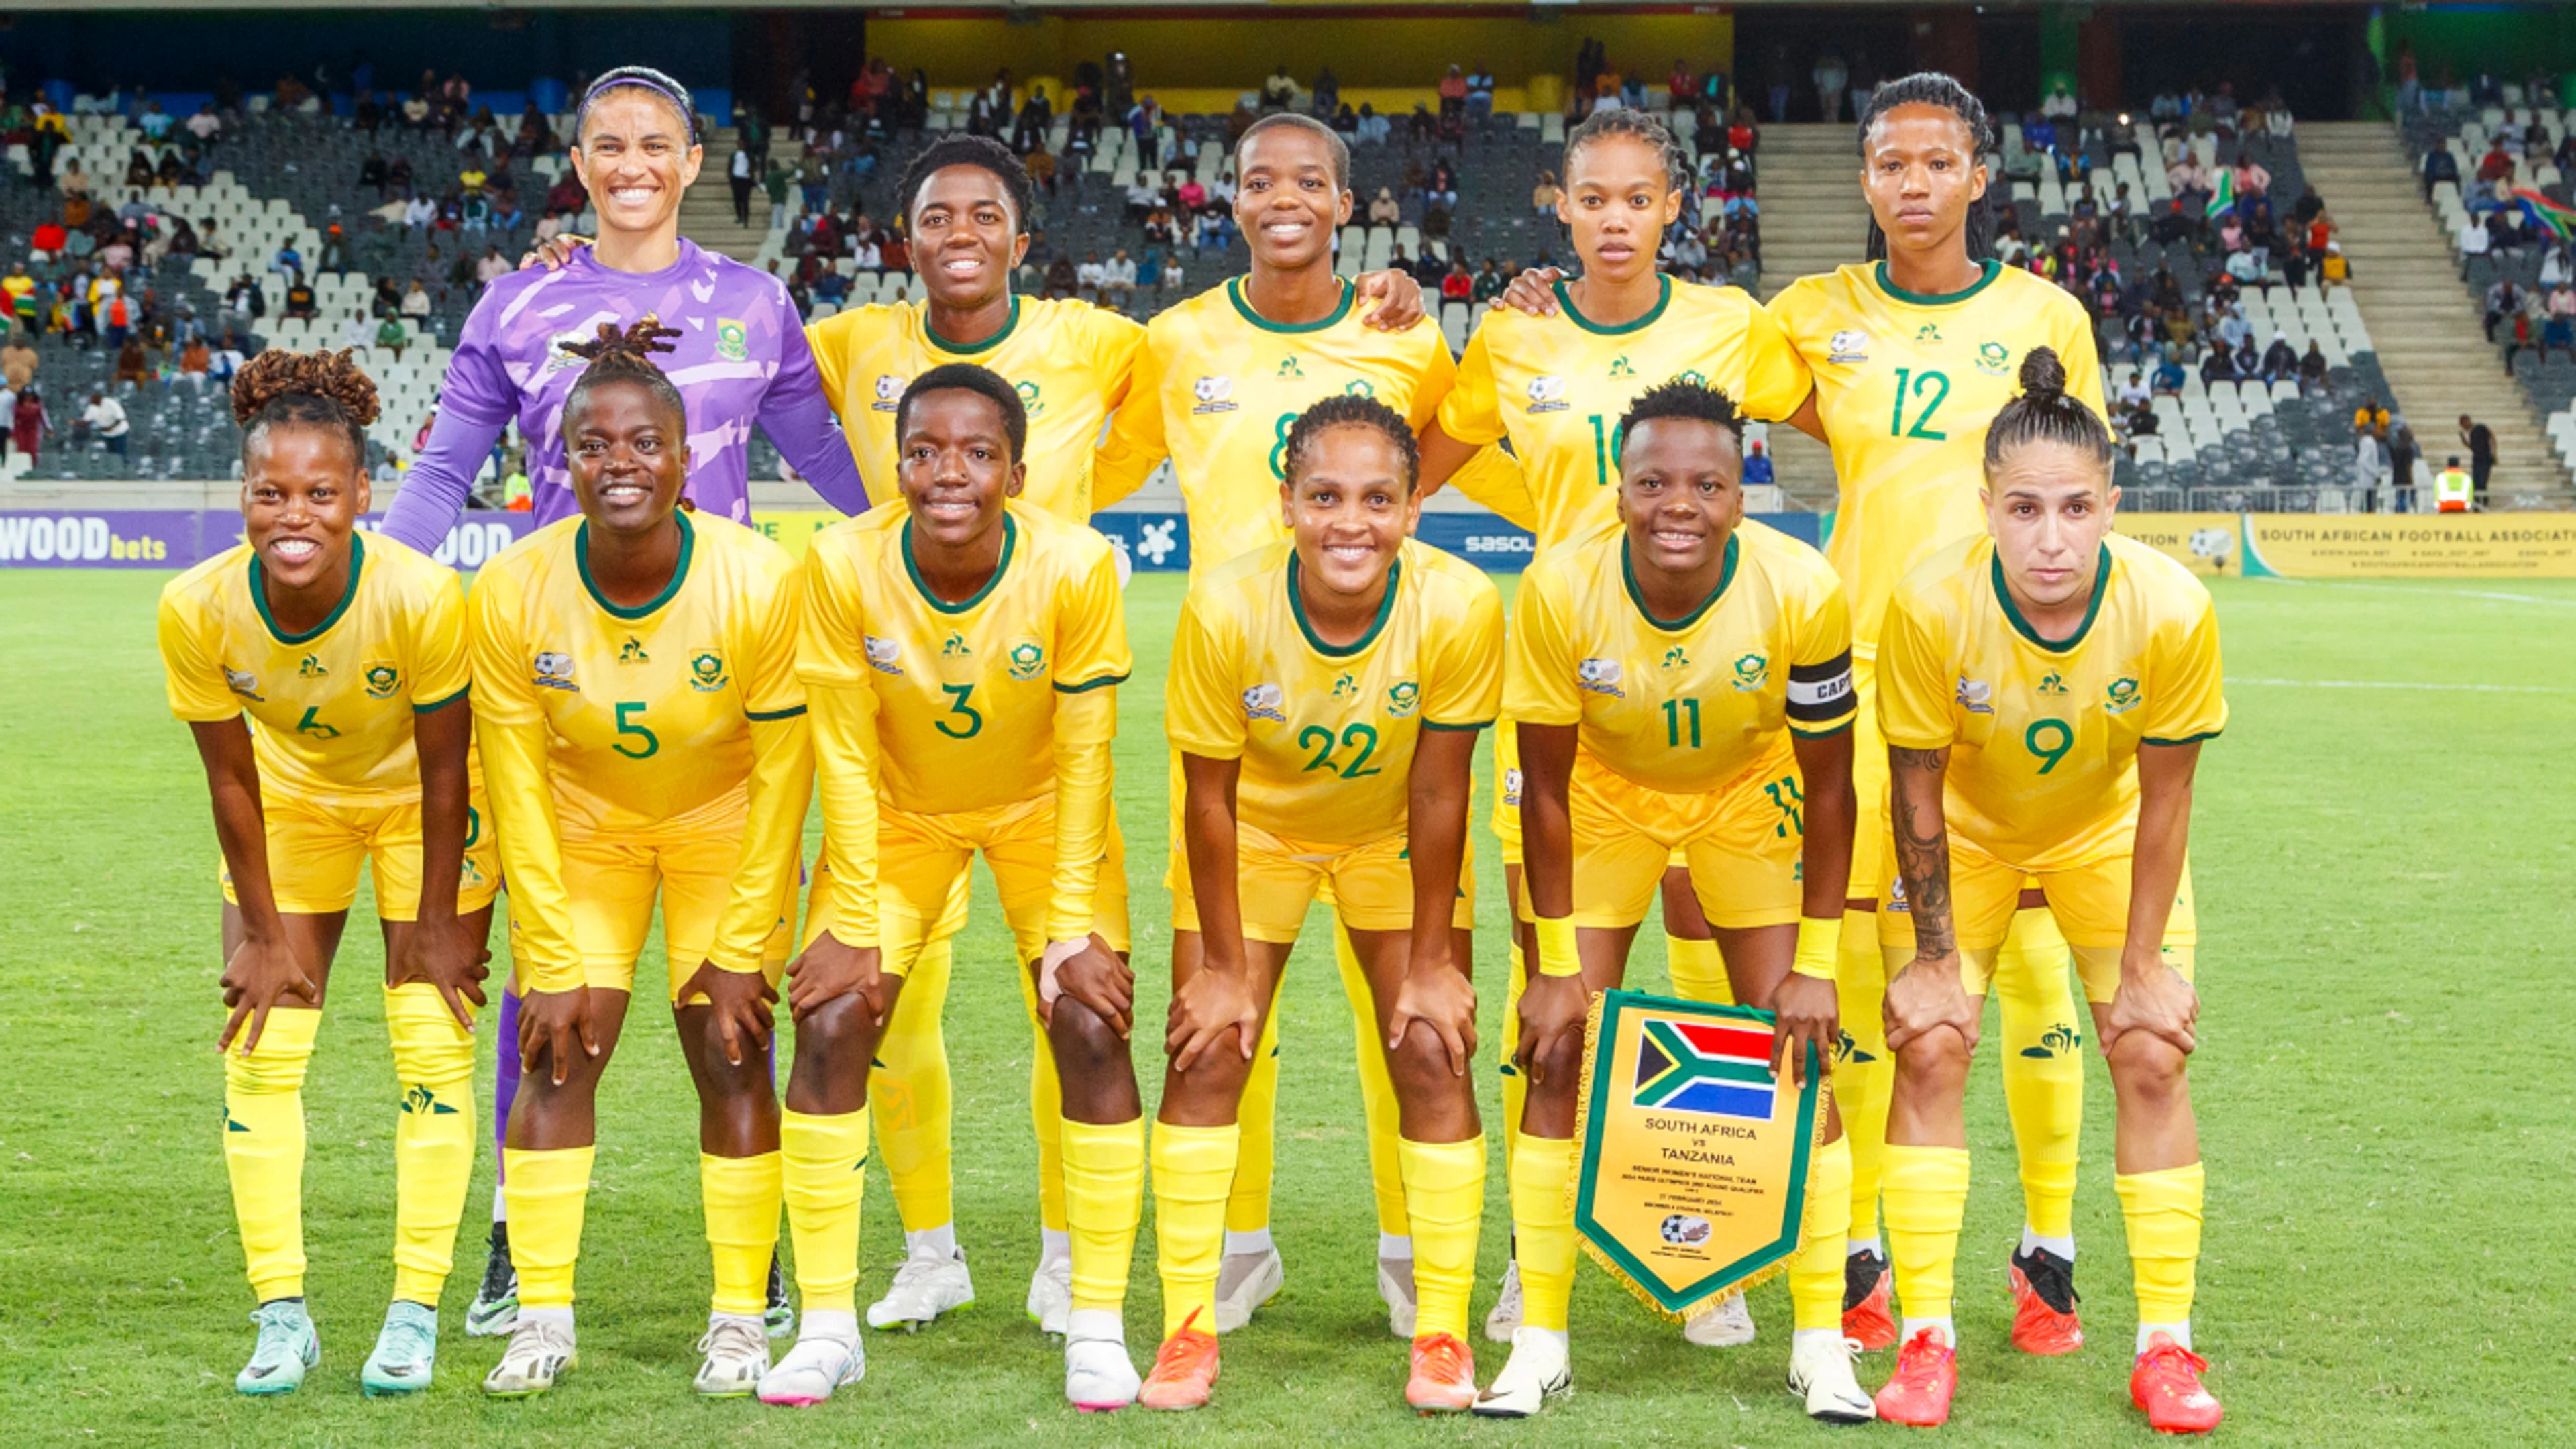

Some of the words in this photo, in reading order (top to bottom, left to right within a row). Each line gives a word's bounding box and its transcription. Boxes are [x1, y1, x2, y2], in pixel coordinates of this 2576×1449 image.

[1891, 367, 1951, 441] 12
[1588, 415, 1623, 485] 1
[110, 533, 166, 561] bets
[2260, 529, 2315, 541] SOUTH
[2320, 529, 2392, 541] AFRICAN
[2399, 529, 2484, 542] FOOTBALL
[296, 706, 341, 739] 6
[612, 702, 659, 759] 5
[934, 683, 982, 739] 3
[1661, 698, 1701, 749] 11
[1298, 723, 1381, 779] 22
[2025, 718, 2074, 775] 9
[1645, 1118, 1697, 1134] SOUTH
[1700, 1124, 1757, 1140] AFRICA
[1661, 1148, 1735, 1166] TANZANIA
